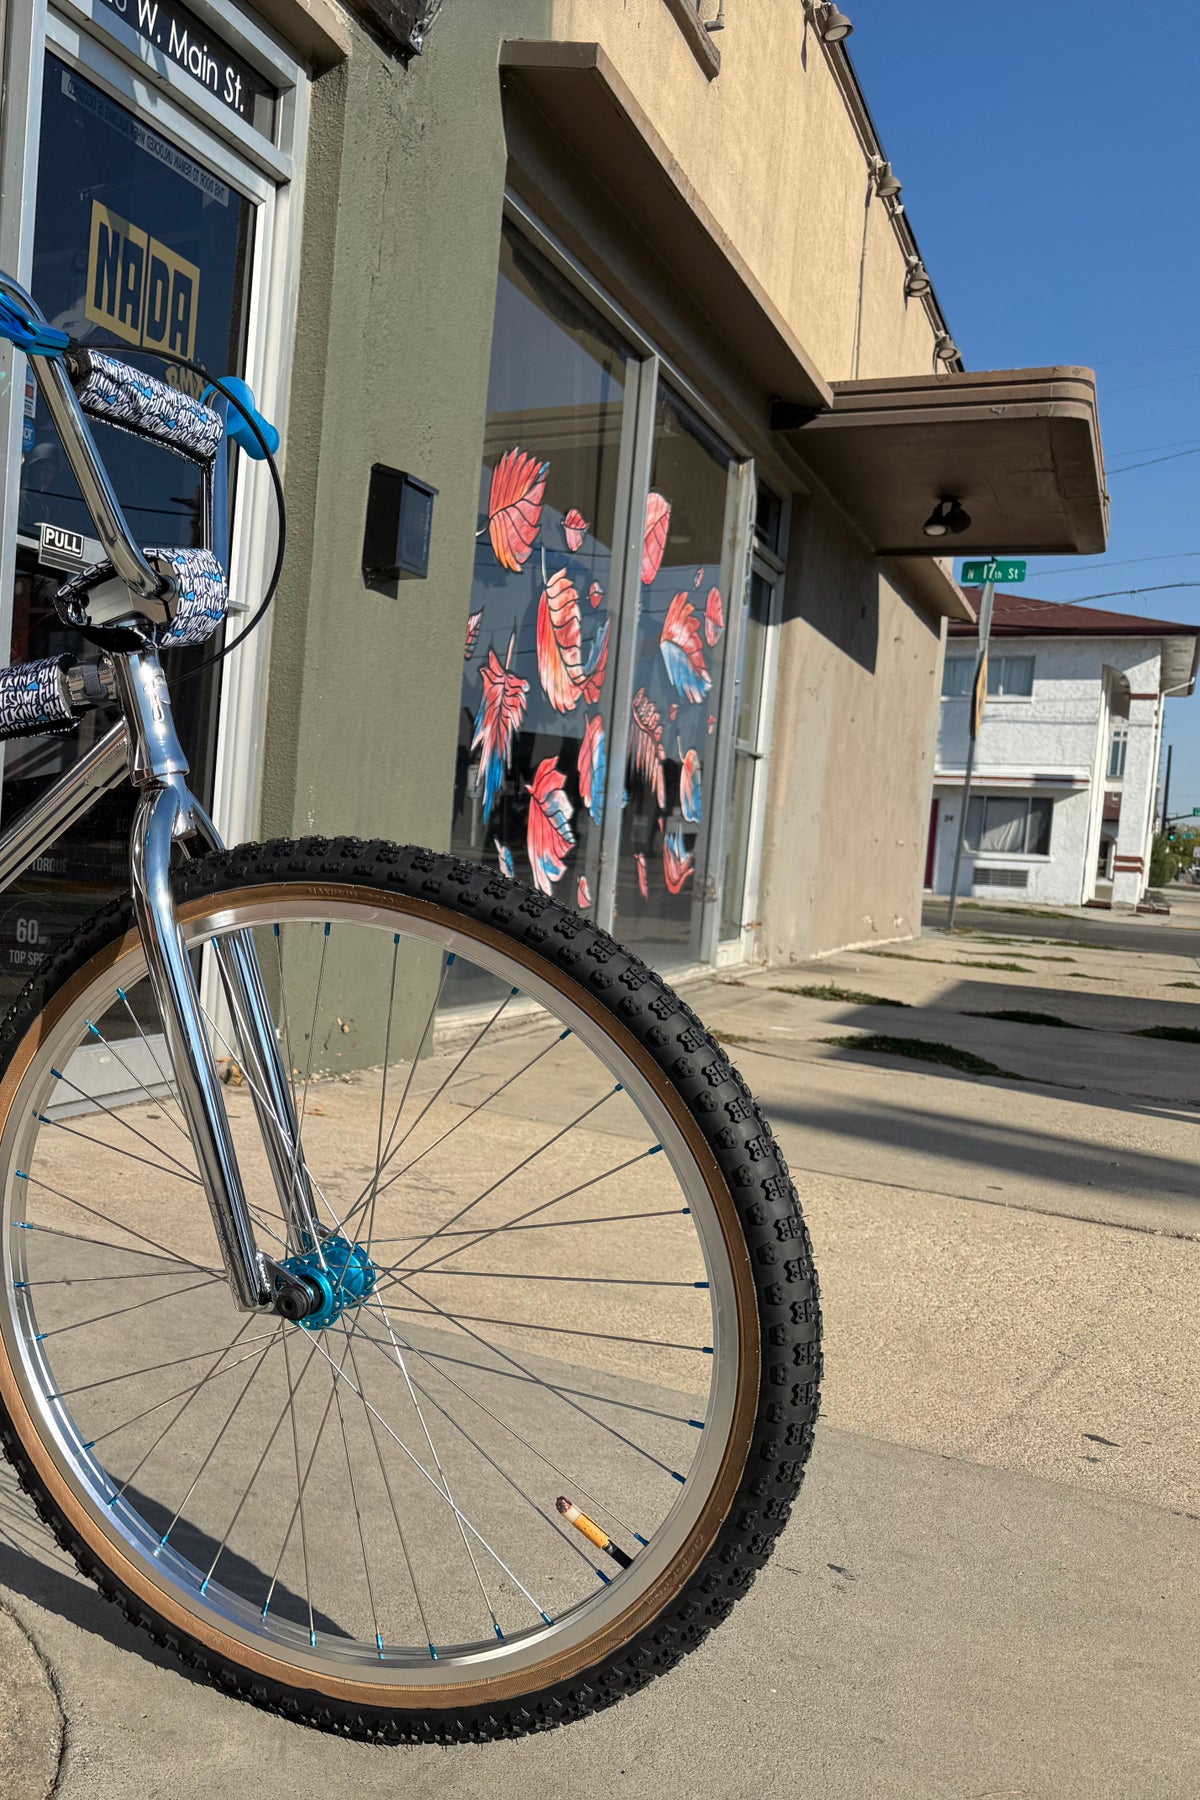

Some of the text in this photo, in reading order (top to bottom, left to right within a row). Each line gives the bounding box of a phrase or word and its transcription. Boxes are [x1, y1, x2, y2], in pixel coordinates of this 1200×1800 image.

[136, 0, 245, 113] W. Main St.
[94, 220, 193, 359] NADA
[45, 528, 80, 553] PULL
[967, 561, 1019, 580] N 17th St
[32, 857, 67, 874] TORQUE
[16, 918, 39, 944] 60
[9, 950, 26, 965] TOP
